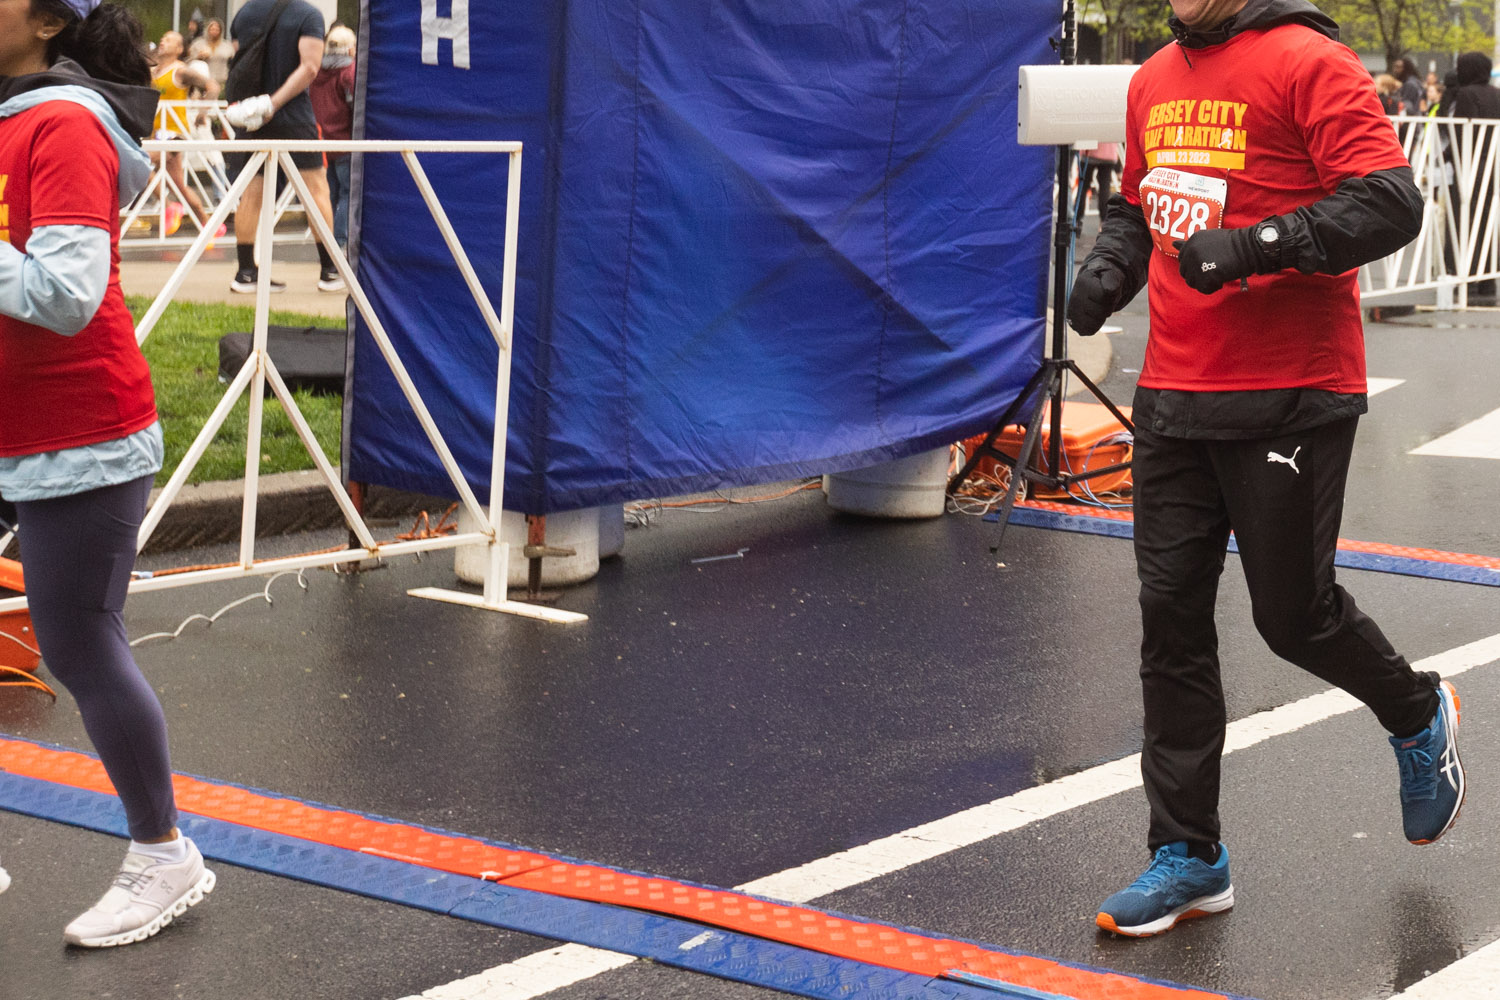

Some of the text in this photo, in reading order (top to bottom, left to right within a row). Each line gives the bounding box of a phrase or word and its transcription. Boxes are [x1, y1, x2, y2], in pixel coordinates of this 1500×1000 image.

[1146, 99, 1248, 129] JERSEY CITY
[1156, 151, 1210, 165] APRIL 23 2023
[1167, 171, 1180, 181] CITY
[1147, 191, 1210, 240] 2328
